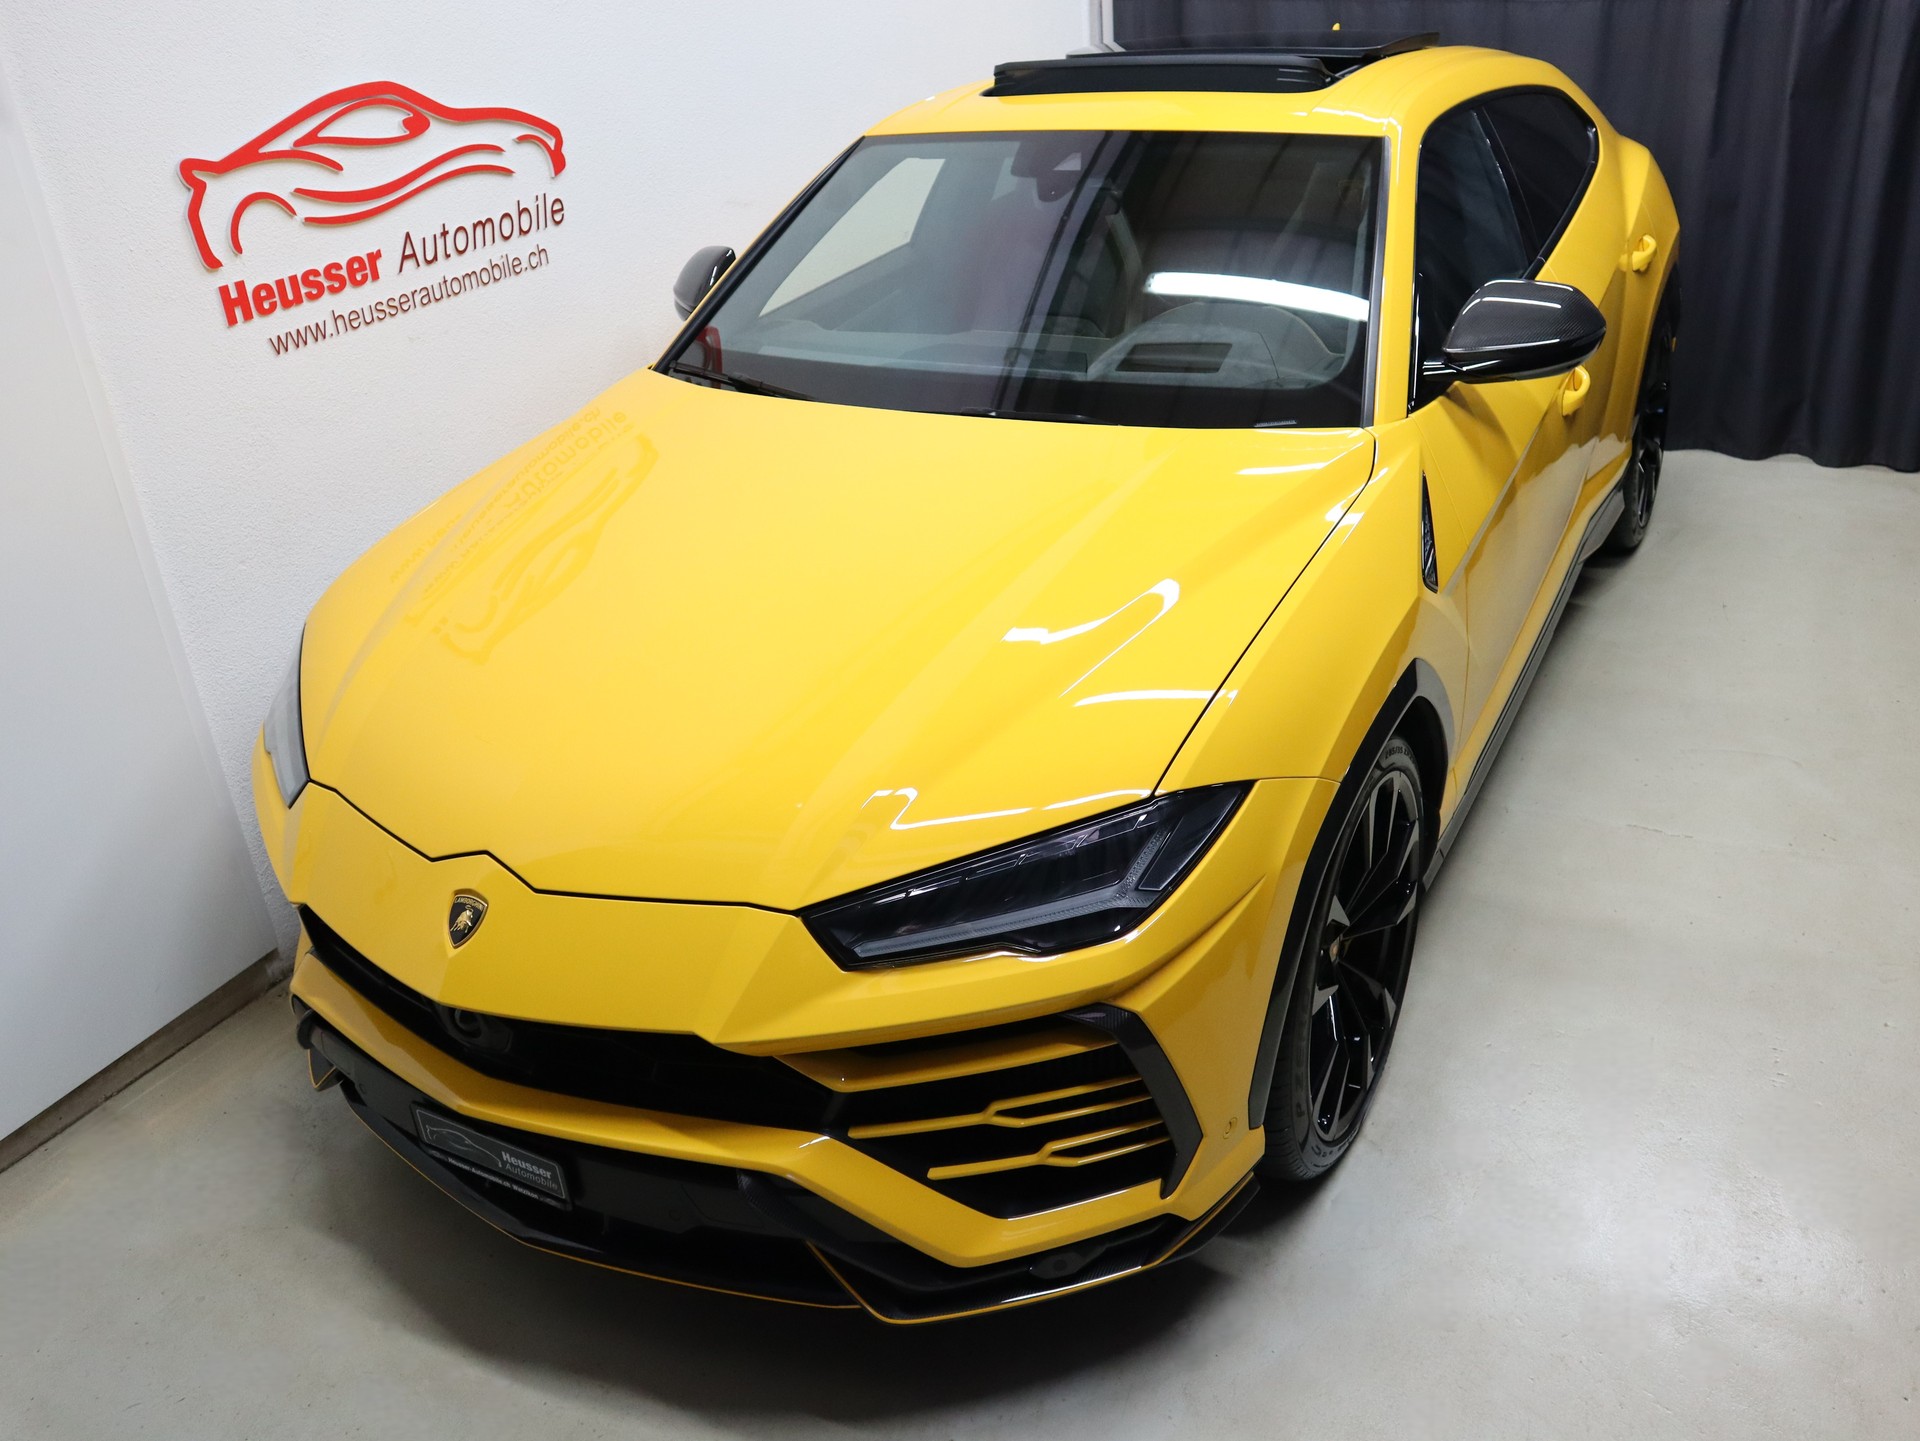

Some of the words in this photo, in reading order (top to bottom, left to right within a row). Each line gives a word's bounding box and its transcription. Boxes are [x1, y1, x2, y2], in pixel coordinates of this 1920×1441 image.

[218, 248, 383, 327] Heusser
[398, 193, 566, 273] Automobile
[269, 243, 549, 356] www.heusserautomobile.ch
[455, 897, 484, 911] LAMBORGHINI
[501, 1151, 552, 1179] Heusser
[505, 1164, 558, 1190] Automobile
